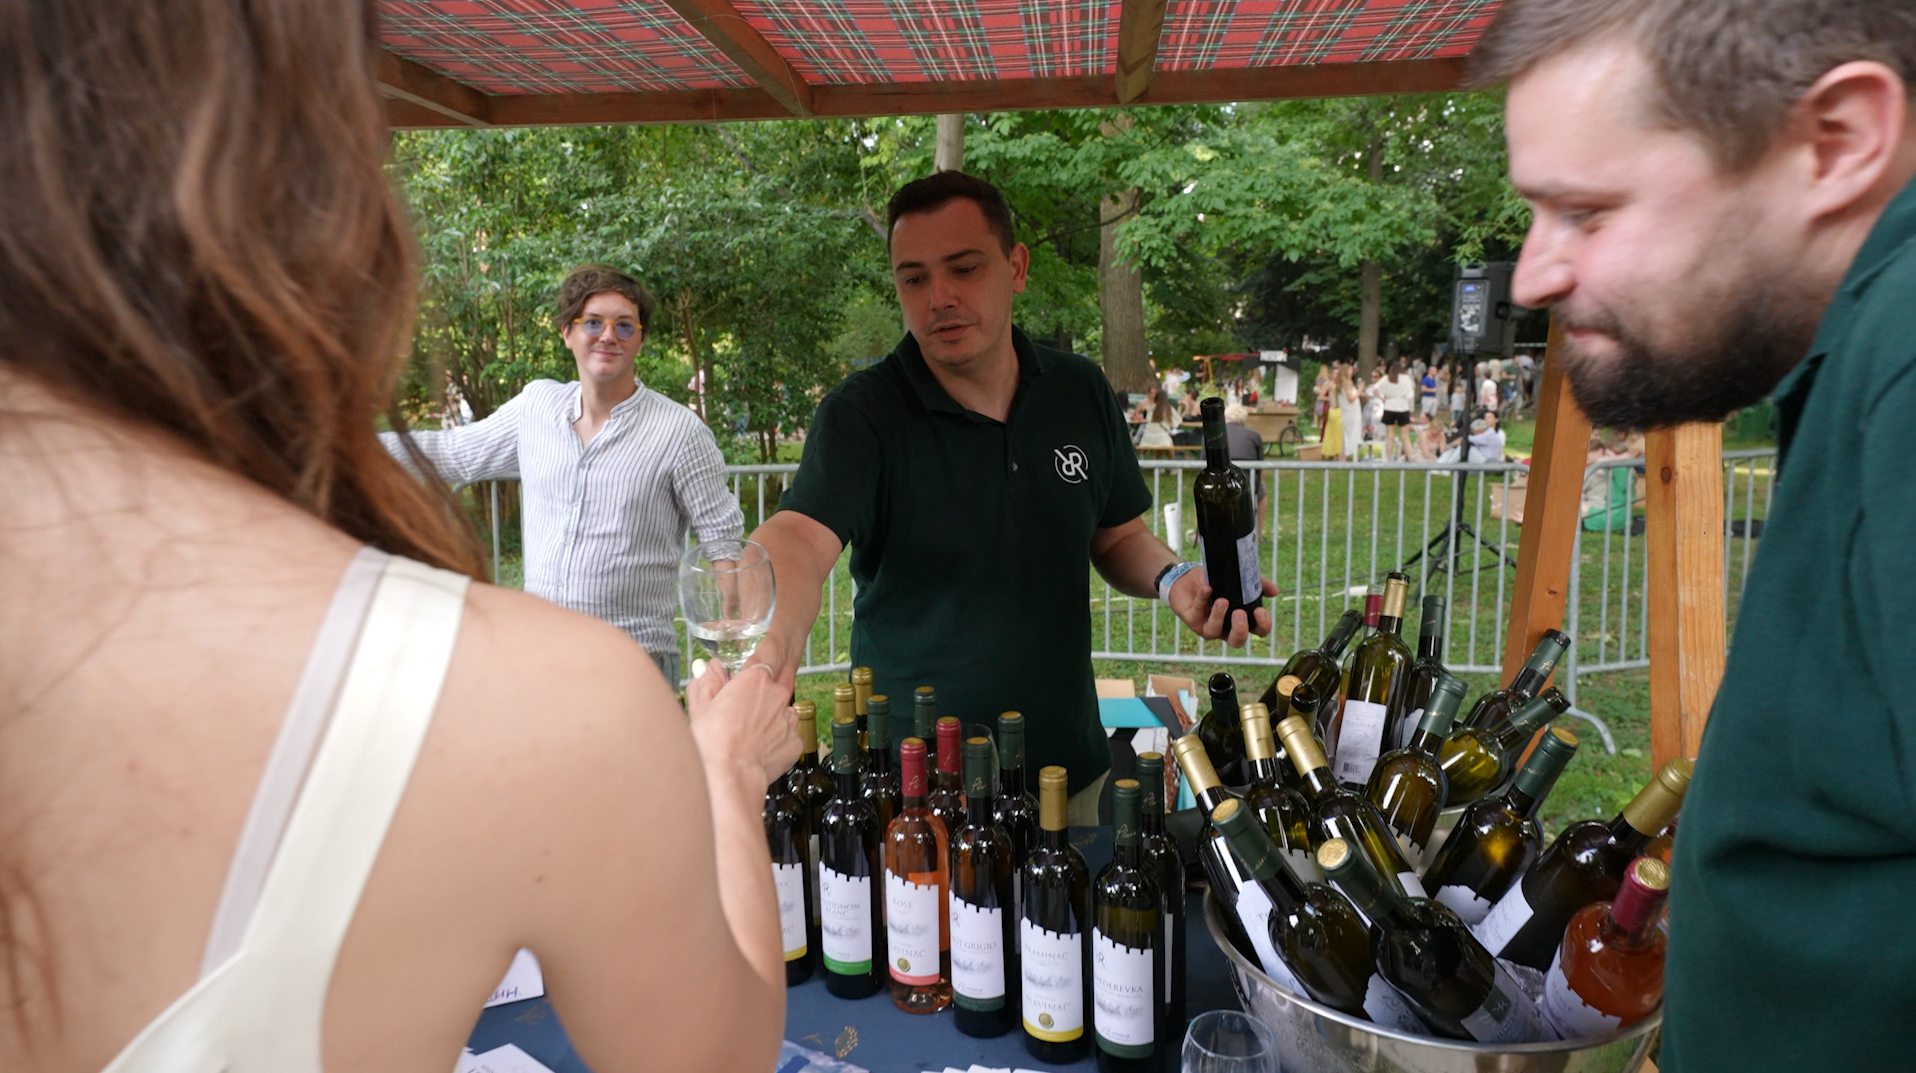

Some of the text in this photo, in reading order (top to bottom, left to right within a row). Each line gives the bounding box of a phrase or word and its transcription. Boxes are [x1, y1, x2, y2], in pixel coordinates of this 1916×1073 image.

[964, 940, 997, 952] GRIGIO
[1024, 942, 1069, 961] TRAMINAC
[1094, 974, 1144, 993] MEDEREVKA
[1025, 994, 1072, 1012] PLAVINAC
